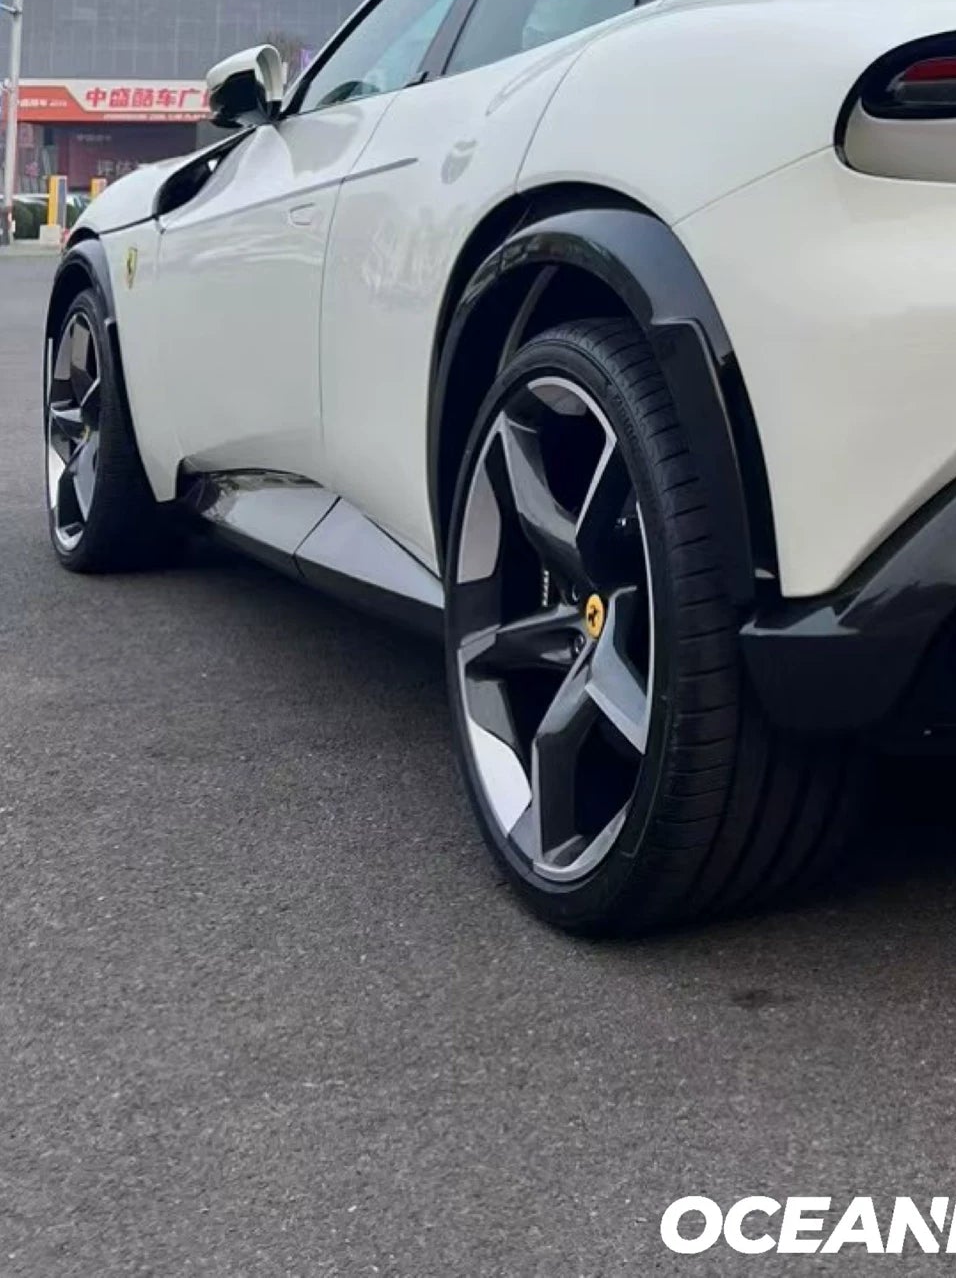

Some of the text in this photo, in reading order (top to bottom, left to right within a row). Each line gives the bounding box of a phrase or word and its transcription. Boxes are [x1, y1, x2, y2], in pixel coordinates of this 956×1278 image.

[85, 86, 208, 109] 中盛酷车广
